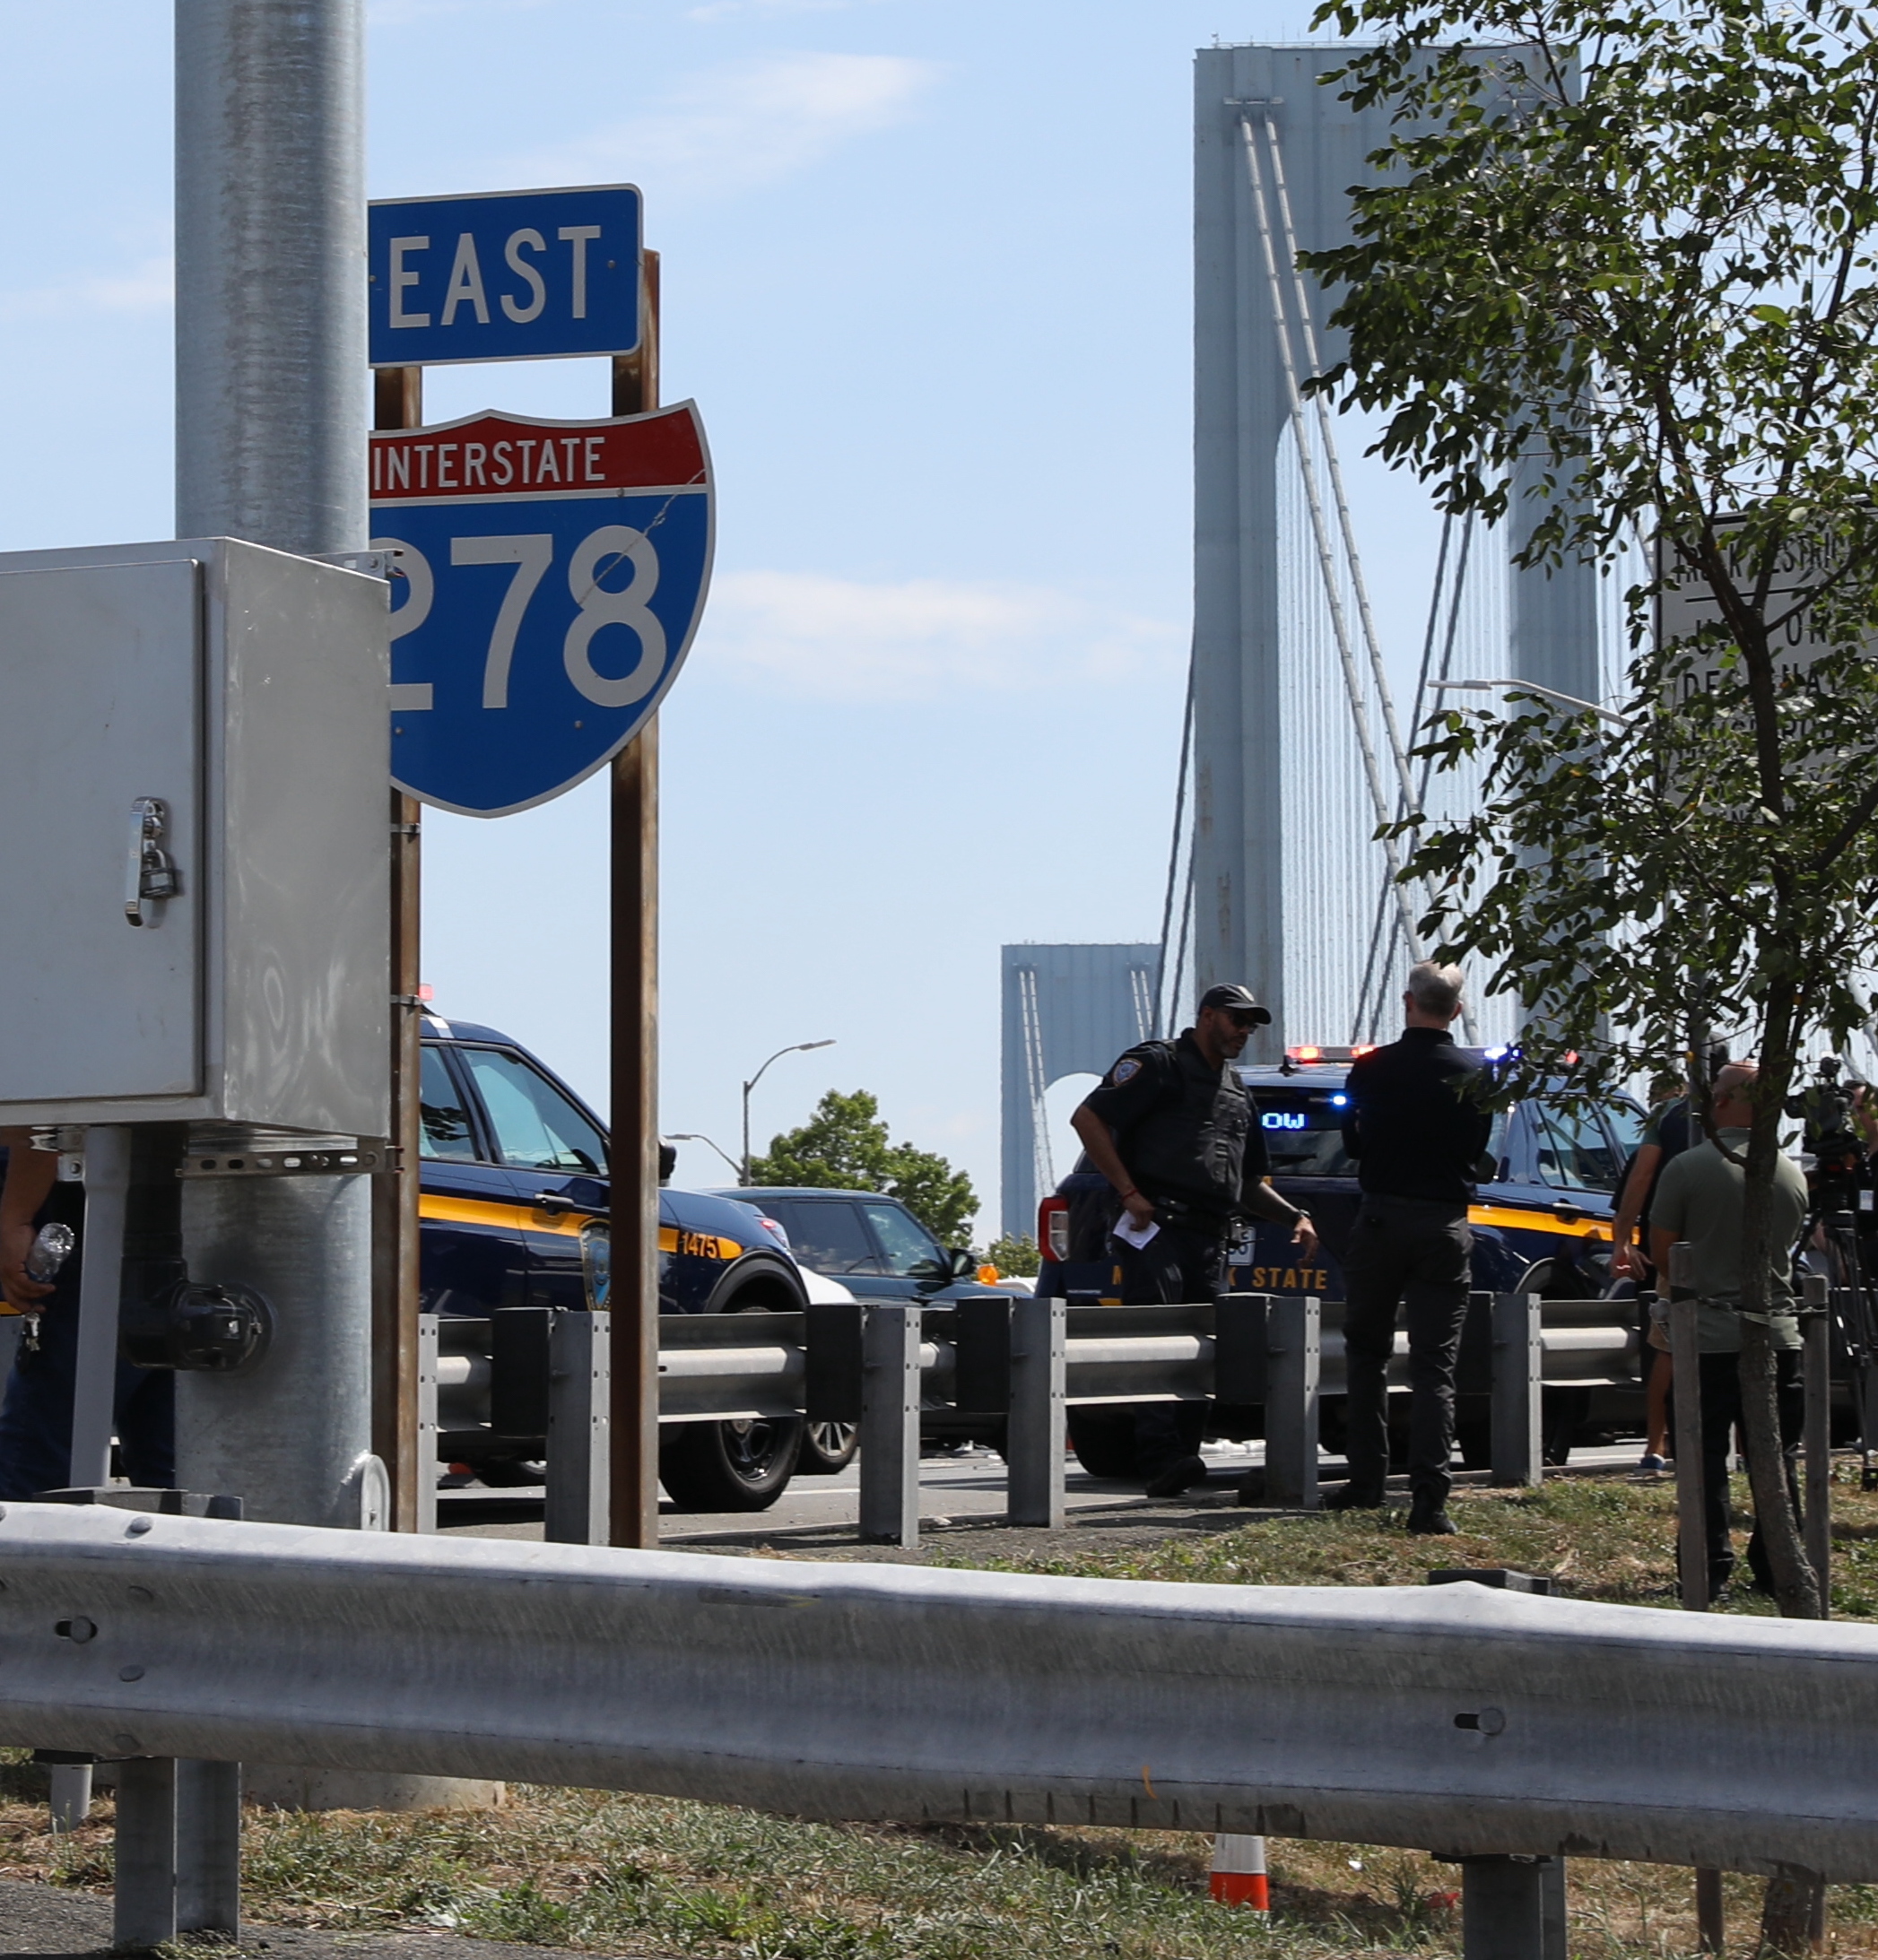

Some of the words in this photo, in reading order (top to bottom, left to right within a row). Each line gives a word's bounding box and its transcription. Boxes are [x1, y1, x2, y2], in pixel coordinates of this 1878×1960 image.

[388, 225, 601, 329] EAST
[373, 436, 606, 490] INTERSTATE
[682, 1232, 717, 1259] 1475
[1252, 1267, 1327, 1289] STATE
